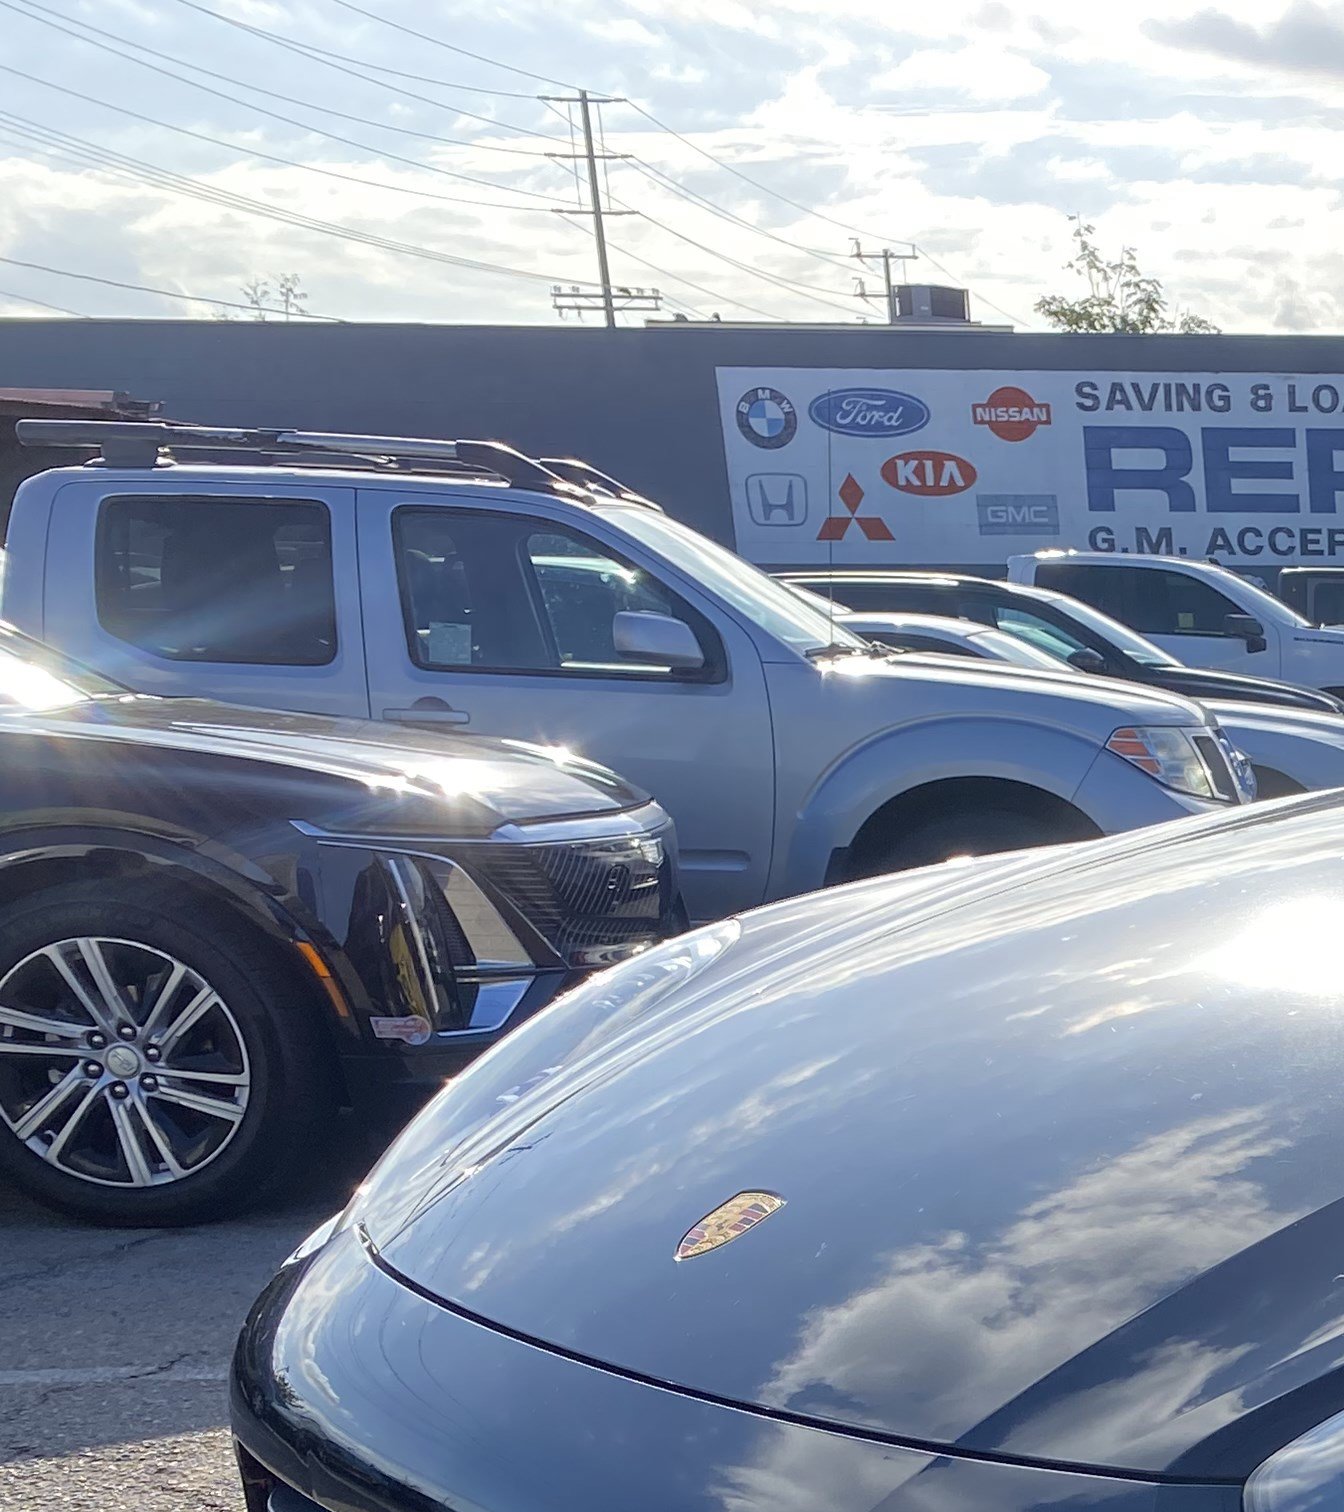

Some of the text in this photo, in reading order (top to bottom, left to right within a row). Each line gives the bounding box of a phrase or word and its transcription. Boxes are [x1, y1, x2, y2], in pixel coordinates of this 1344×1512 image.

[738, 389, 793, 414] BMW
[1074, 381, 1232, 413] SAVING
[1250, 383, 1273, 412] &
[836, 397, 903, 426] Ford
[975, 407, 1047, 422] NISSAN
[895, 459, 965, 487] KIA
[987, 506, 1049, 523] GMC
[1088, 526, 1187, 555] G.M.
